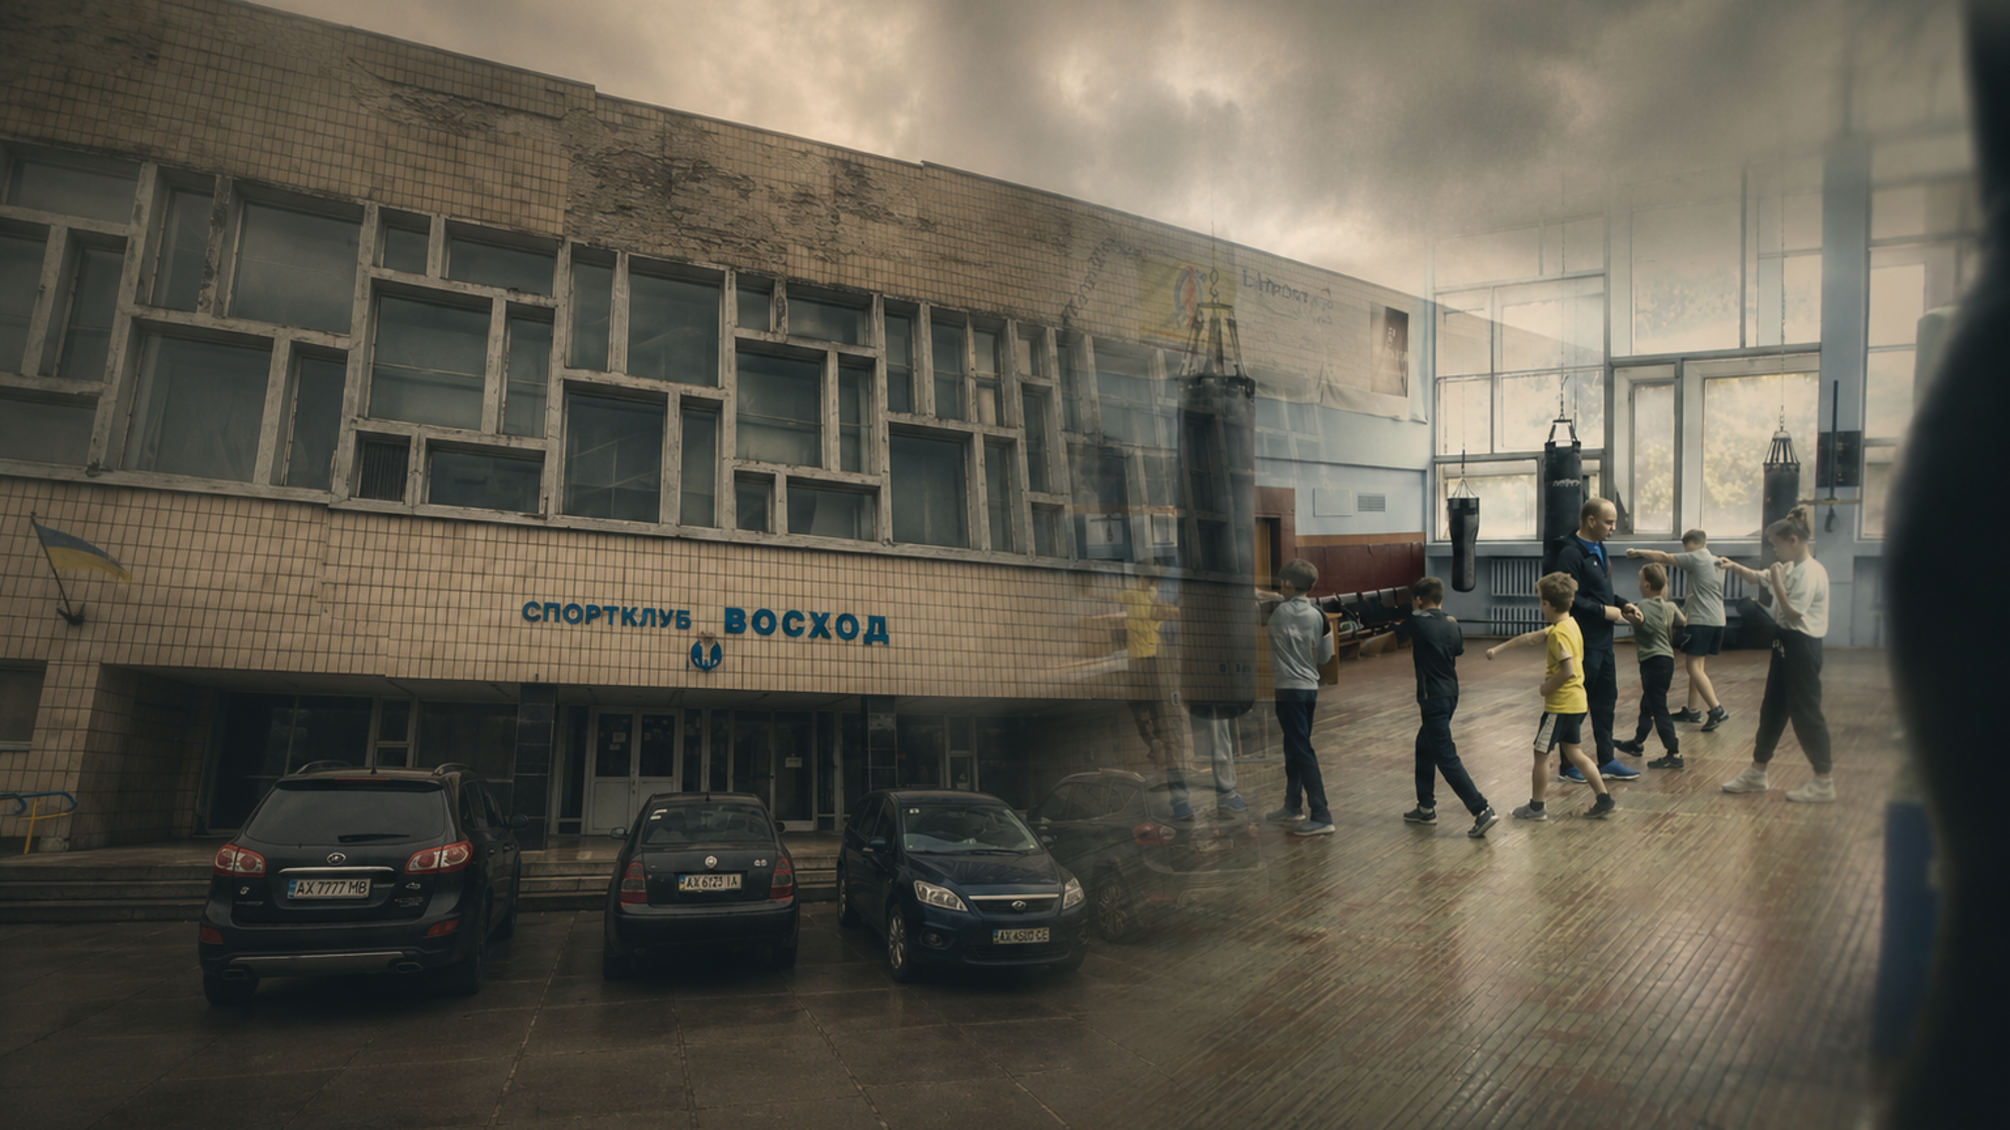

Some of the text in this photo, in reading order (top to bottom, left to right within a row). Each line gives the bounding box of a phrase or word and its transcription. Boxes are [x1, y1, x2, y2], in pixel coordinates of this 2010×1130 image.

[521, 600, 890, 646] СПОРТКЛУБ ВОСХОД
[296, 880, 367, 895] AX 7777 MB
